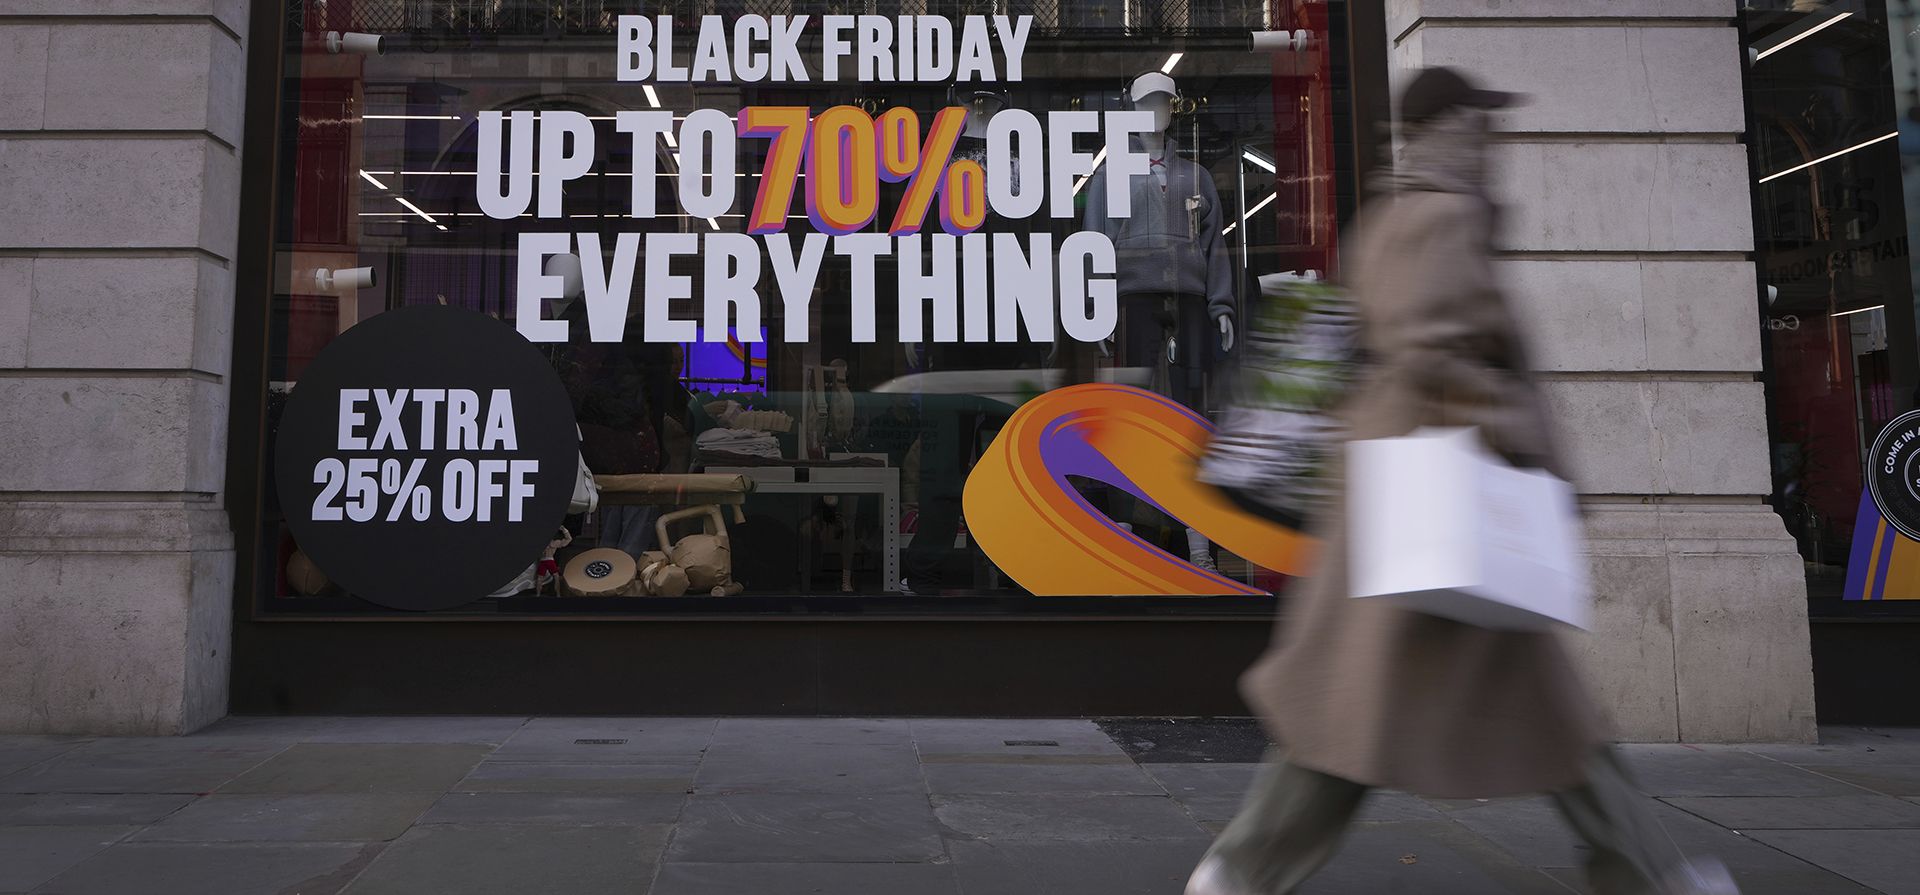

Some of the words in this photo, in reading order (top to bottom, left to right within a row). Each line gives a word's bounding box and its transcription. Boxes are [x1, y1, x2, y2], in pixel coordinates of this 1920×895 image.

[617, 14, 809, 82] BLACK
[823, 14, 1033, 82] FRIDAY
[477, 110, 596, 219] UP
[616, 109, 736, 219] TO
[737, 104, 987, 236] 70%
[986, 109, 1155, 219] OFF
[516, 231, 1118, 343] EVERYTHING
[338, 388, 518, 450] EXTRA
[1884, 439, 1905, 474] COME
[1901, 429, 1916, 443] IN
[312, 459, 431, 522] 25%
[442, 459, 539, 522] OFF
